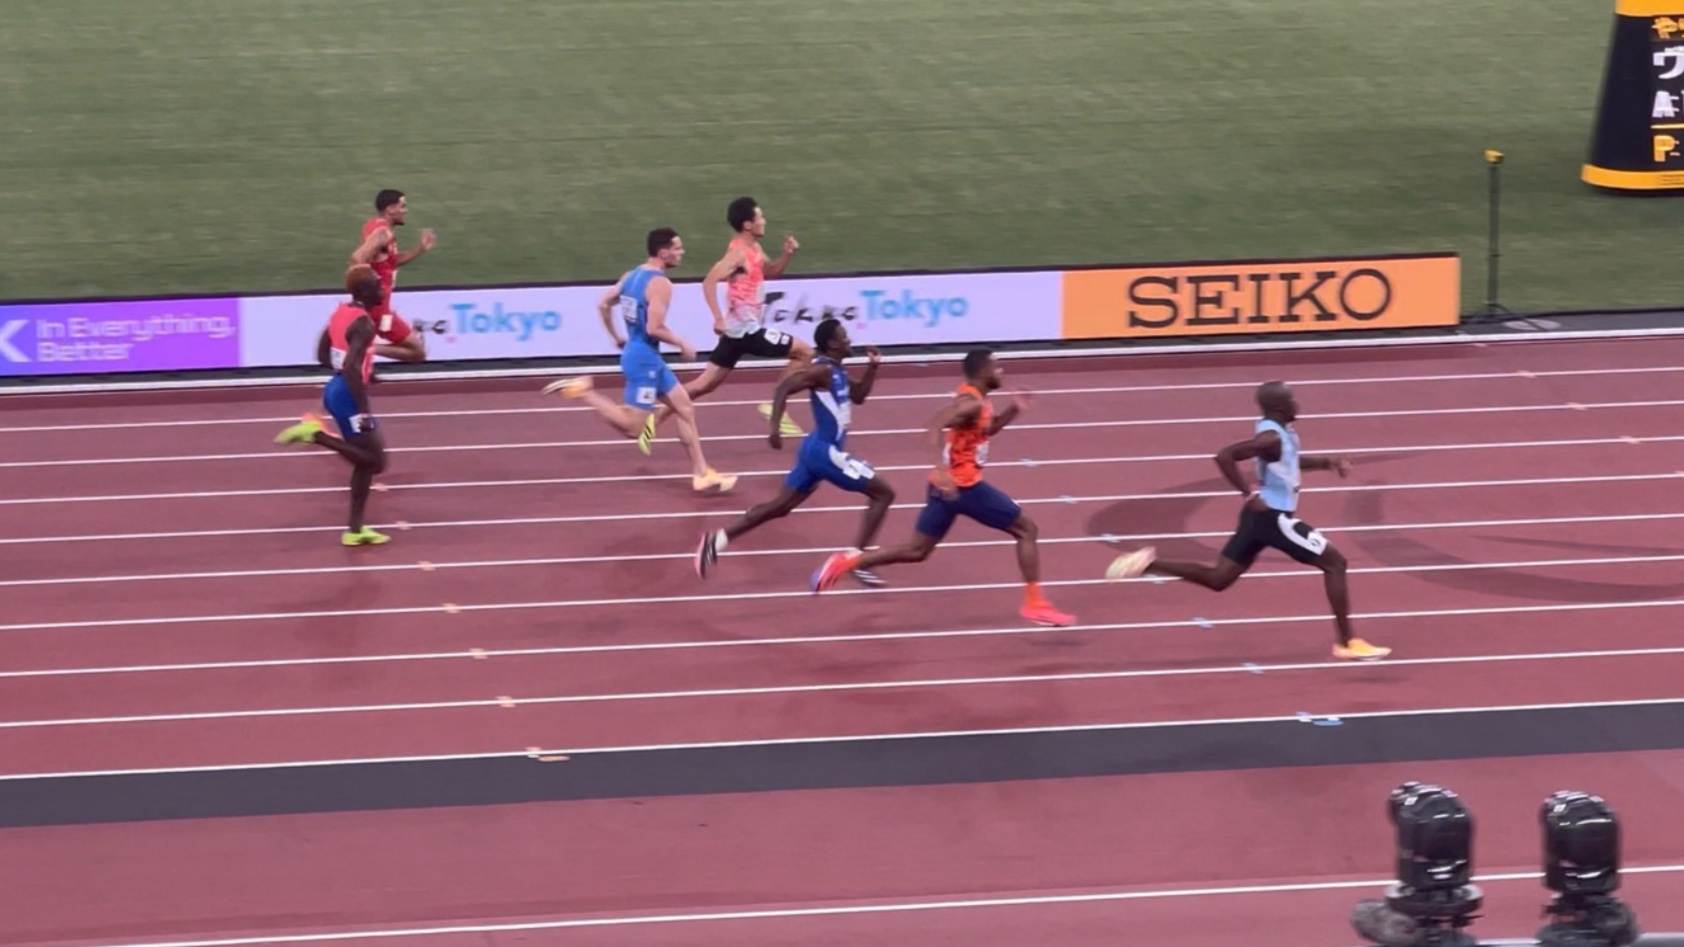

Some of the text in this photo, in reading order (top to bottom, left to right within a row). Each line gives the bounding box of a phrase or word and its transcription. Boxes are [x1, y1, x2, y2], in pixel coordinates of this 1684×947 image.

[859, 289, 968, 328] Tokyo
[1127, 267, 1391, 328] SEIKO
[36, 319, 65, 339] In
[450, 303, 562, 342] Tokyo
[36, 342, 133, 362] Better
